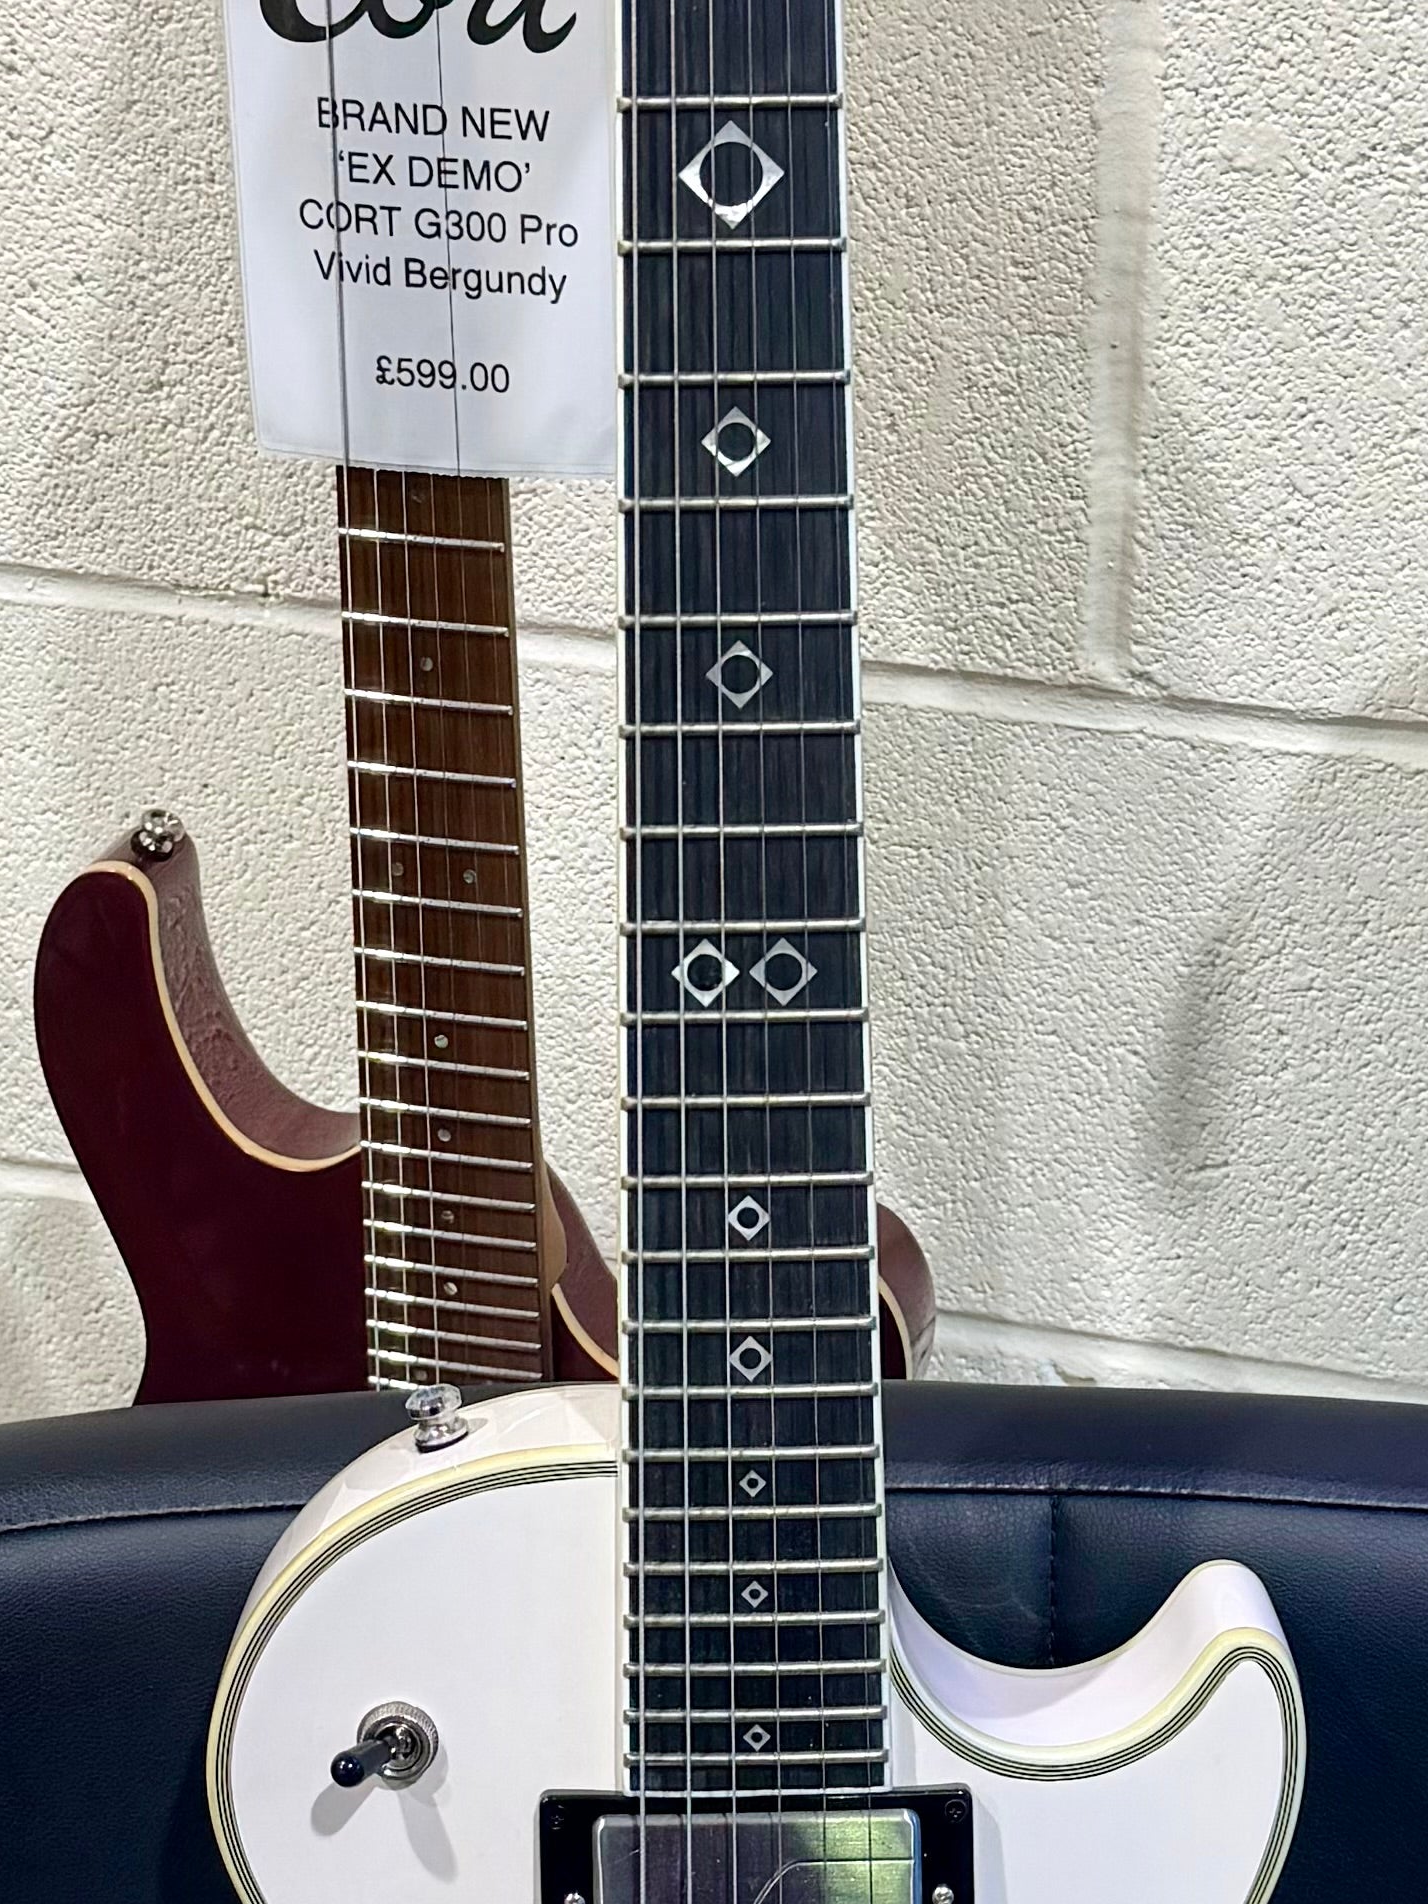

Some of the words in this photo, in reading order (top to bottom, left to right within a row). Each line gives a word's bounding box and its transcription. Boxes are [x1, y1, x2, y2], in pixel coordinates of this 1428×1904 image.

[317, 96, 448, 136] BRAND
[462, 105, 549, 142] NEW
[299, 198, 401, 237] CORT
[414, 207, 507, 243] G300
[521, 213, 578, 247] Pro
[313, 248, 391, 286] Vivid
[404, 256, 567, 305] Bergundy
[375, 355, 510, 393] £599.00
